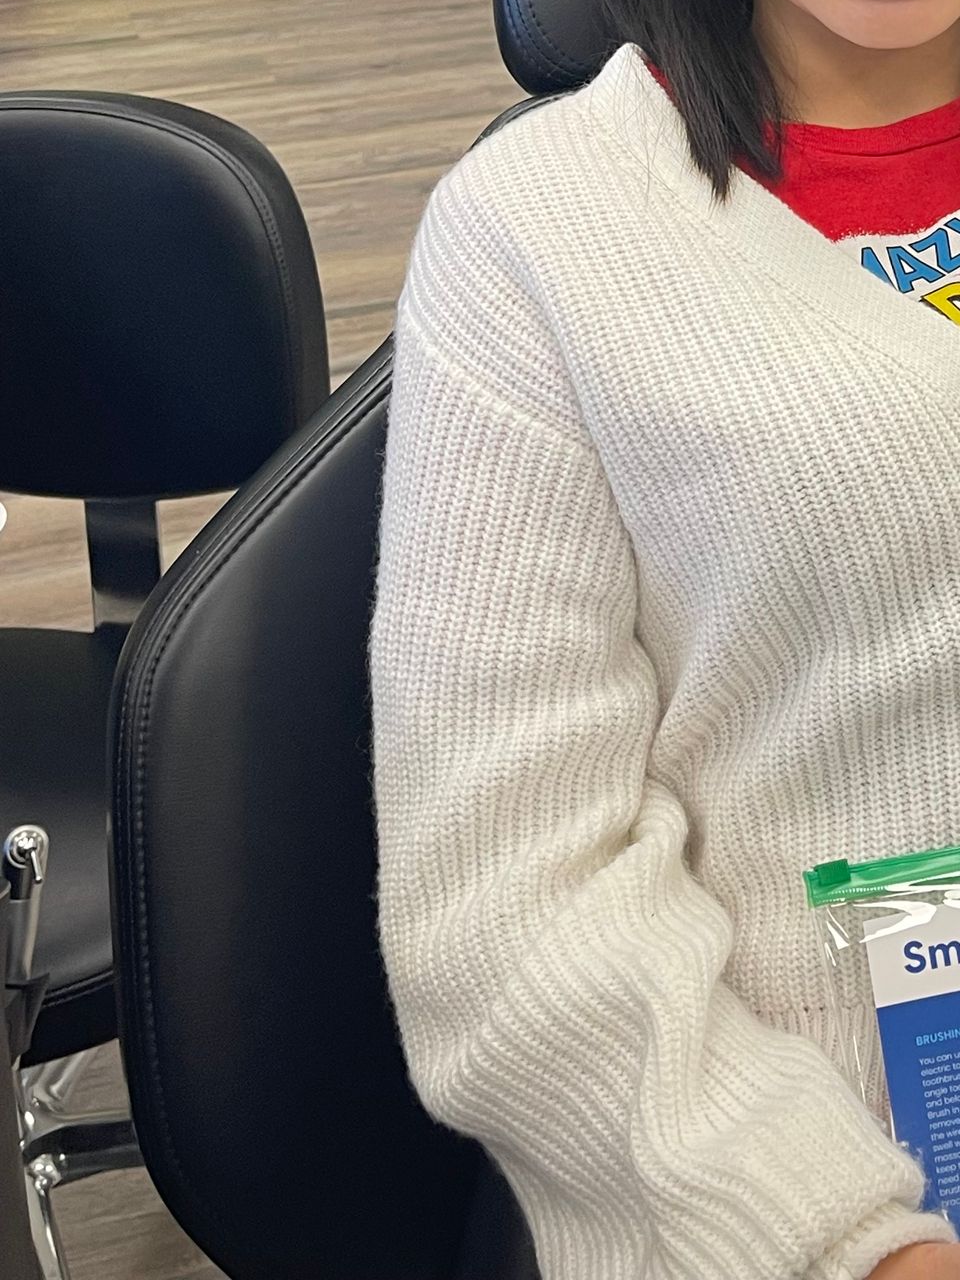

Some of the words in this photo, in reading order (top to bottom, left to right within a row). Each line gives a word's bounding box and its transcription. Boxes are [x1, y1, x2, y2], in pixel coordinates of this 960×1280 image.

[936, 1053, 952, 1062] can
[921, 1063, 951, 1076] electric
[924, 1085, 948, 1098] angle
[926, 1097, 942, 1108] and
[927, 1108, 950, 1120] Brush
[952, 1106, 960, 1114] in
[929, 1118, 960, 1130] remove
[931, 1131, 945, 1141] the
